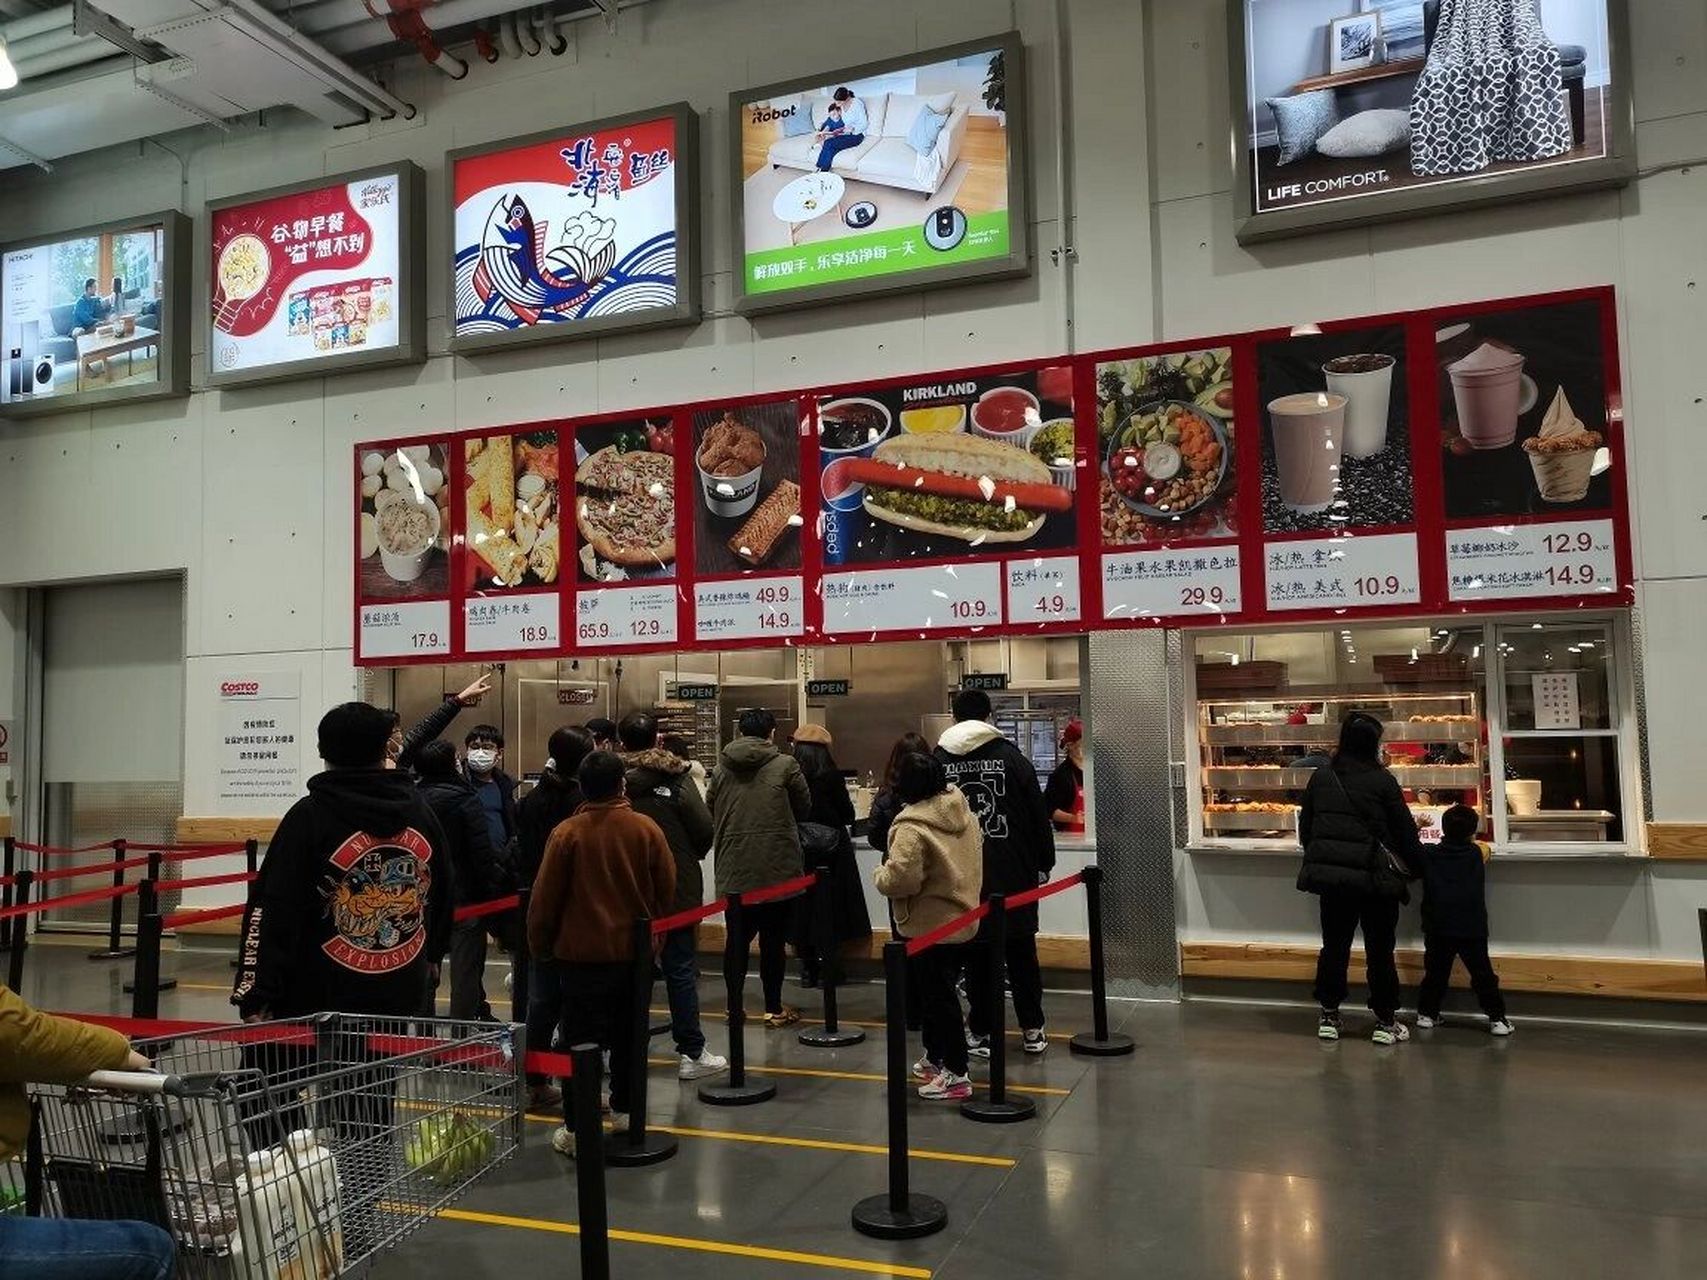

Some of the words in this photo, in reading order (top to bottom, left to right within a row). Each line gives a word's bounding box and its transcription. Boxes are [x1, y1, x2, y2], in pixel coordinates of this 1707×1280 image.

[1268, 184, 1301, 200] LIFE
[271, 212, 344, 244] 谷物早餐
[903, 382, 977, 402] KIRKLAND
[826, 510, 840, 555] pepsi
[1543, 532, 1593, 554] 12.9
[1545, 564, 1595, 586] 14.9
[756, 586, 790, 603] 49.9
[1314, 578, 1345, 593] 美式
[1354, 576, 1400, 596] 10.9
[1036, 595, 1064, 613] 4.9
[1181, 586, 1223, 606] 299
[950, 600, 986, 618] 10.9
[630, 619, 660, 636] 12.9
[758, 612, 790, 629] 14.9
[411, 632, 438, 648] 17.9
[519, 625, 548, 642] 18.9
[579, 622, 609, 640] 65.9
[811, 683, 845, 693] OPEN
[964, 678, 1001, 688] OPEN
[681, 688, 713, 698] OPEN
[350, 831, 419, 854] NUAR
[243, 907, 263, 966] NUCLEAR
